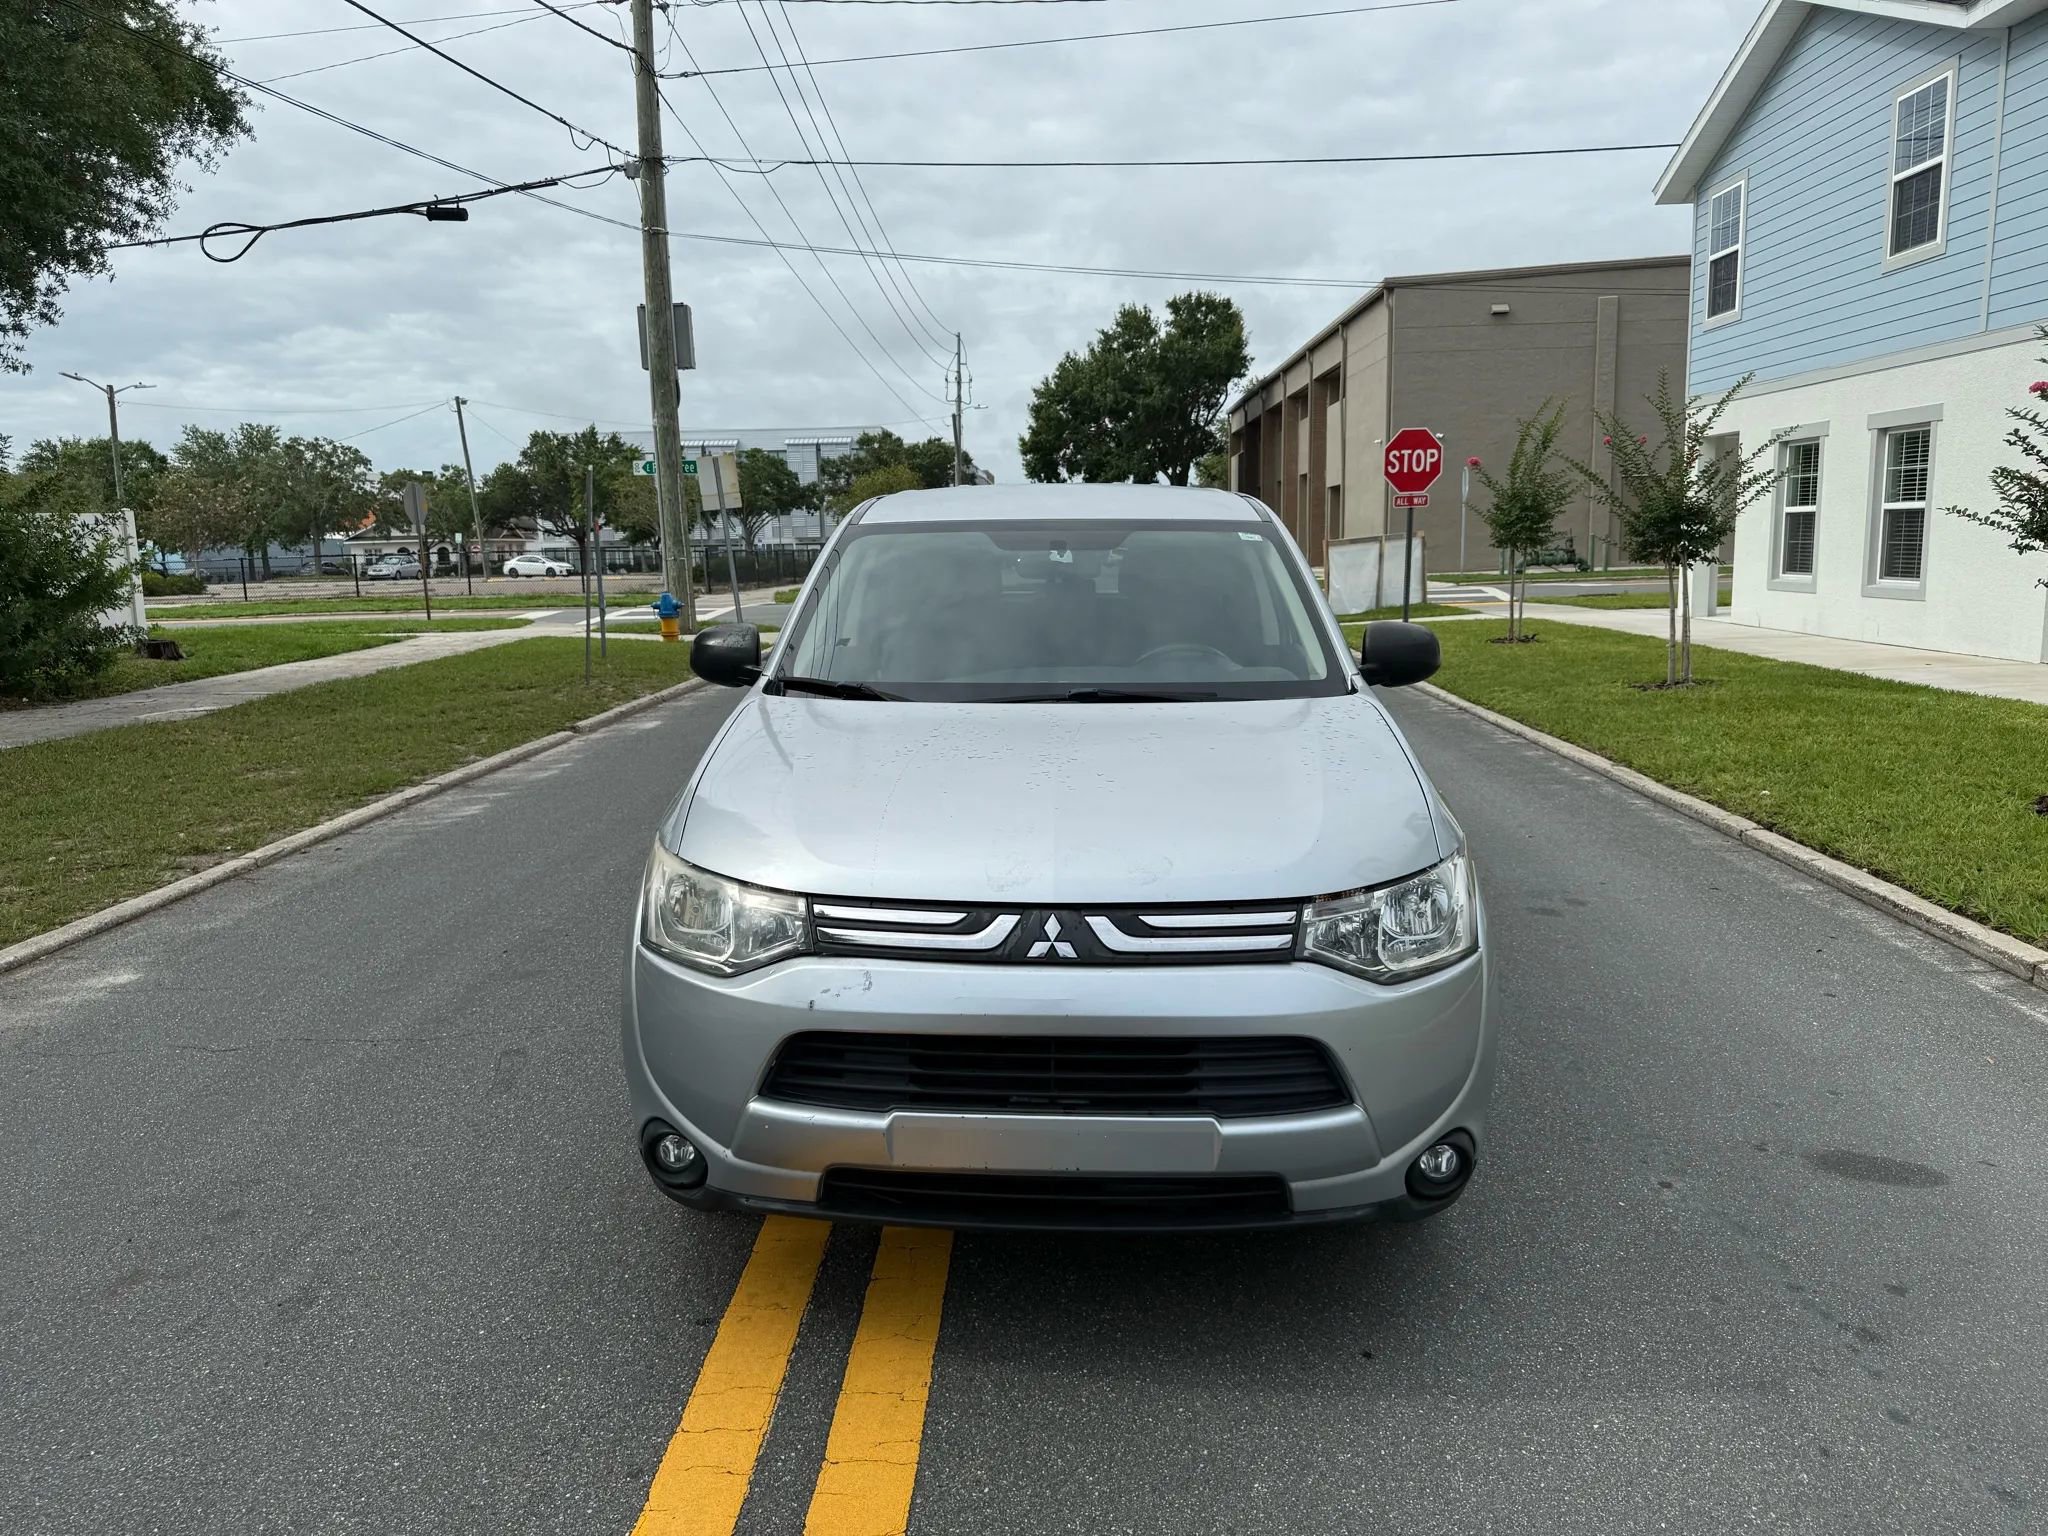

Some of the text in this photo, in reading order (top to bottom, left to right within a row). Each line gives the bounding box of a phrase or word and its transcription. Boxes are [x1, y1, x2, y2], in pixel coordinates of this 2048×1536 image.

[1387, 448, 1439, 474] STOP
[1395, 496, 1427, 506] ALL WAY
